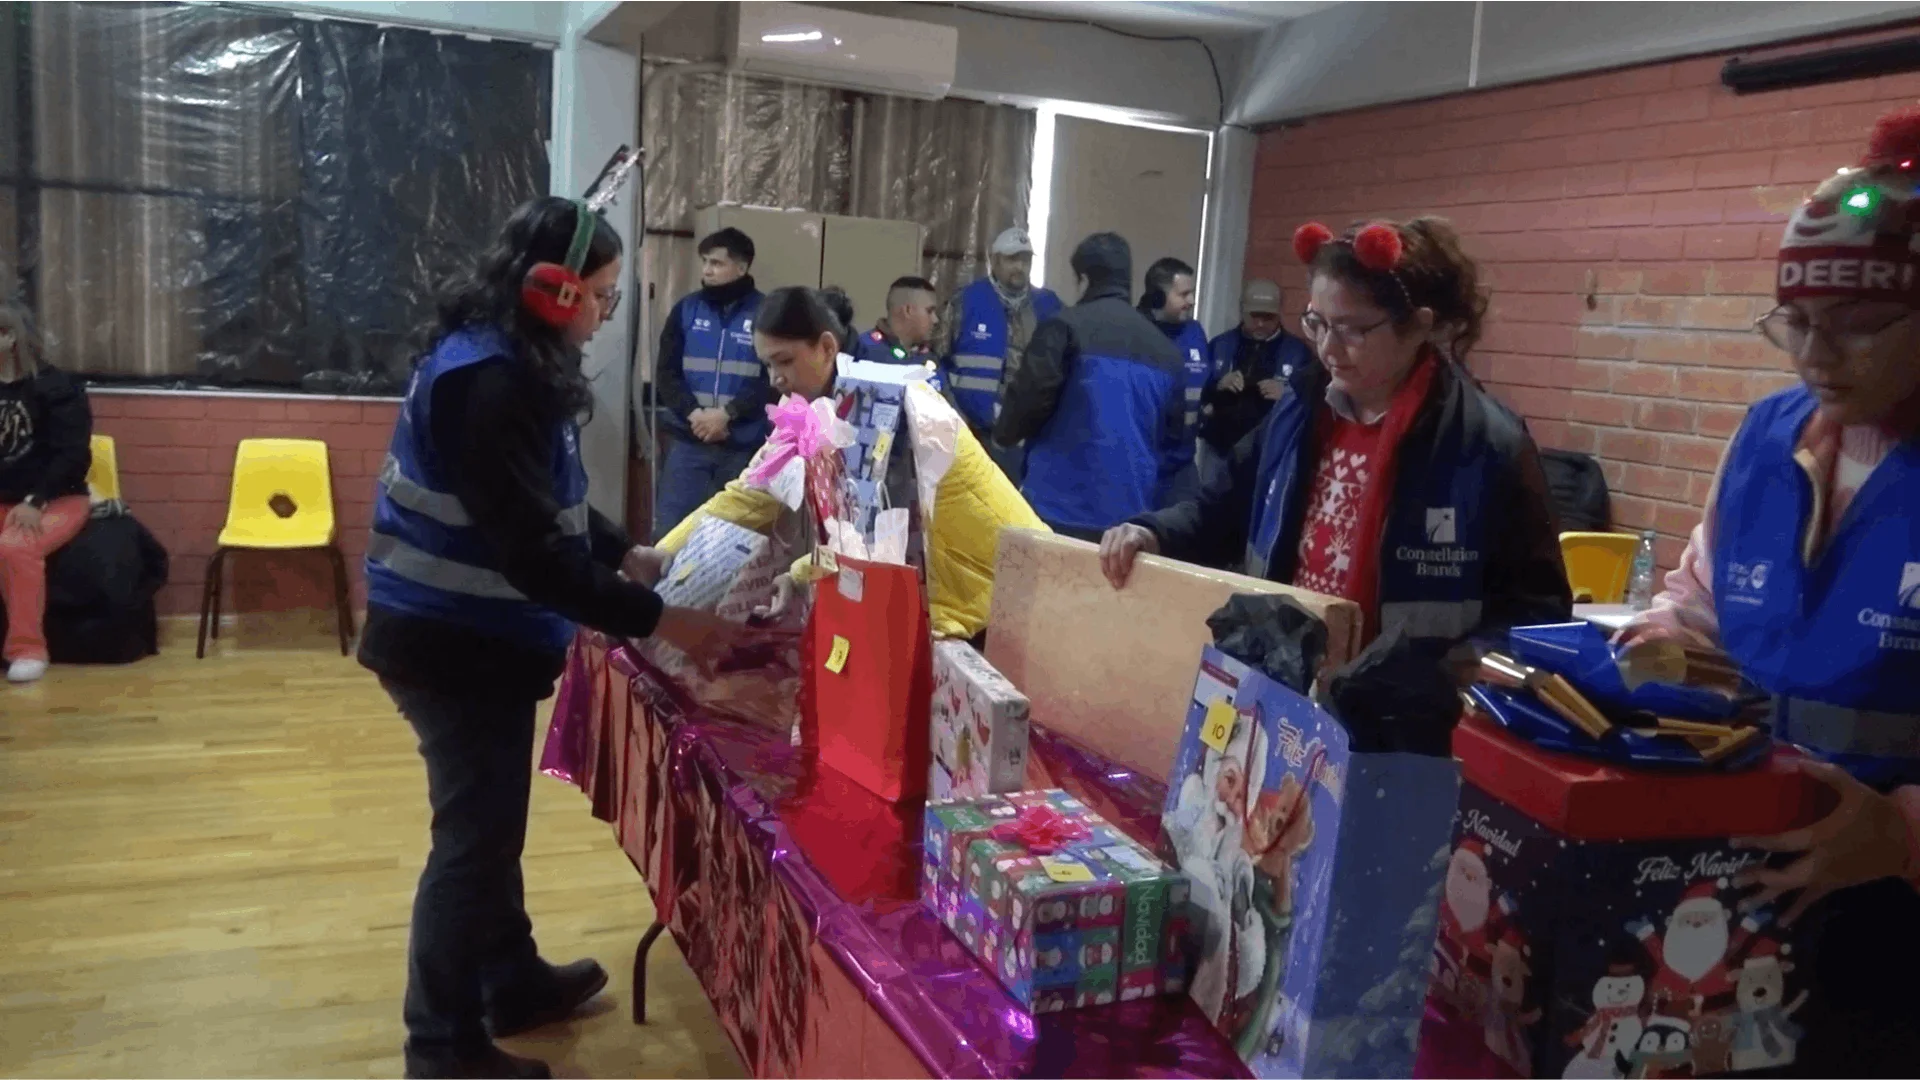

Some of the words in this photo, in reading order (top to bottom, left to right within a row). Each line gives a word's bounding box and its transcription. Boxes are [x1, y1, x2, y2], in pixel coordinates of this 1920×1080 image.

[1397, 546, 1479, 561] Constellation
[1417, 562, 1462, 577] Brands
[1212, 722, 1225, 740] 10
[1462, 808, 1523, 858] Navidad
[1633, 856, 1682, 885] Feliz
[1683, 850, 1769, 881] Navid
[1133, 884, 1156, 965] Navidad
